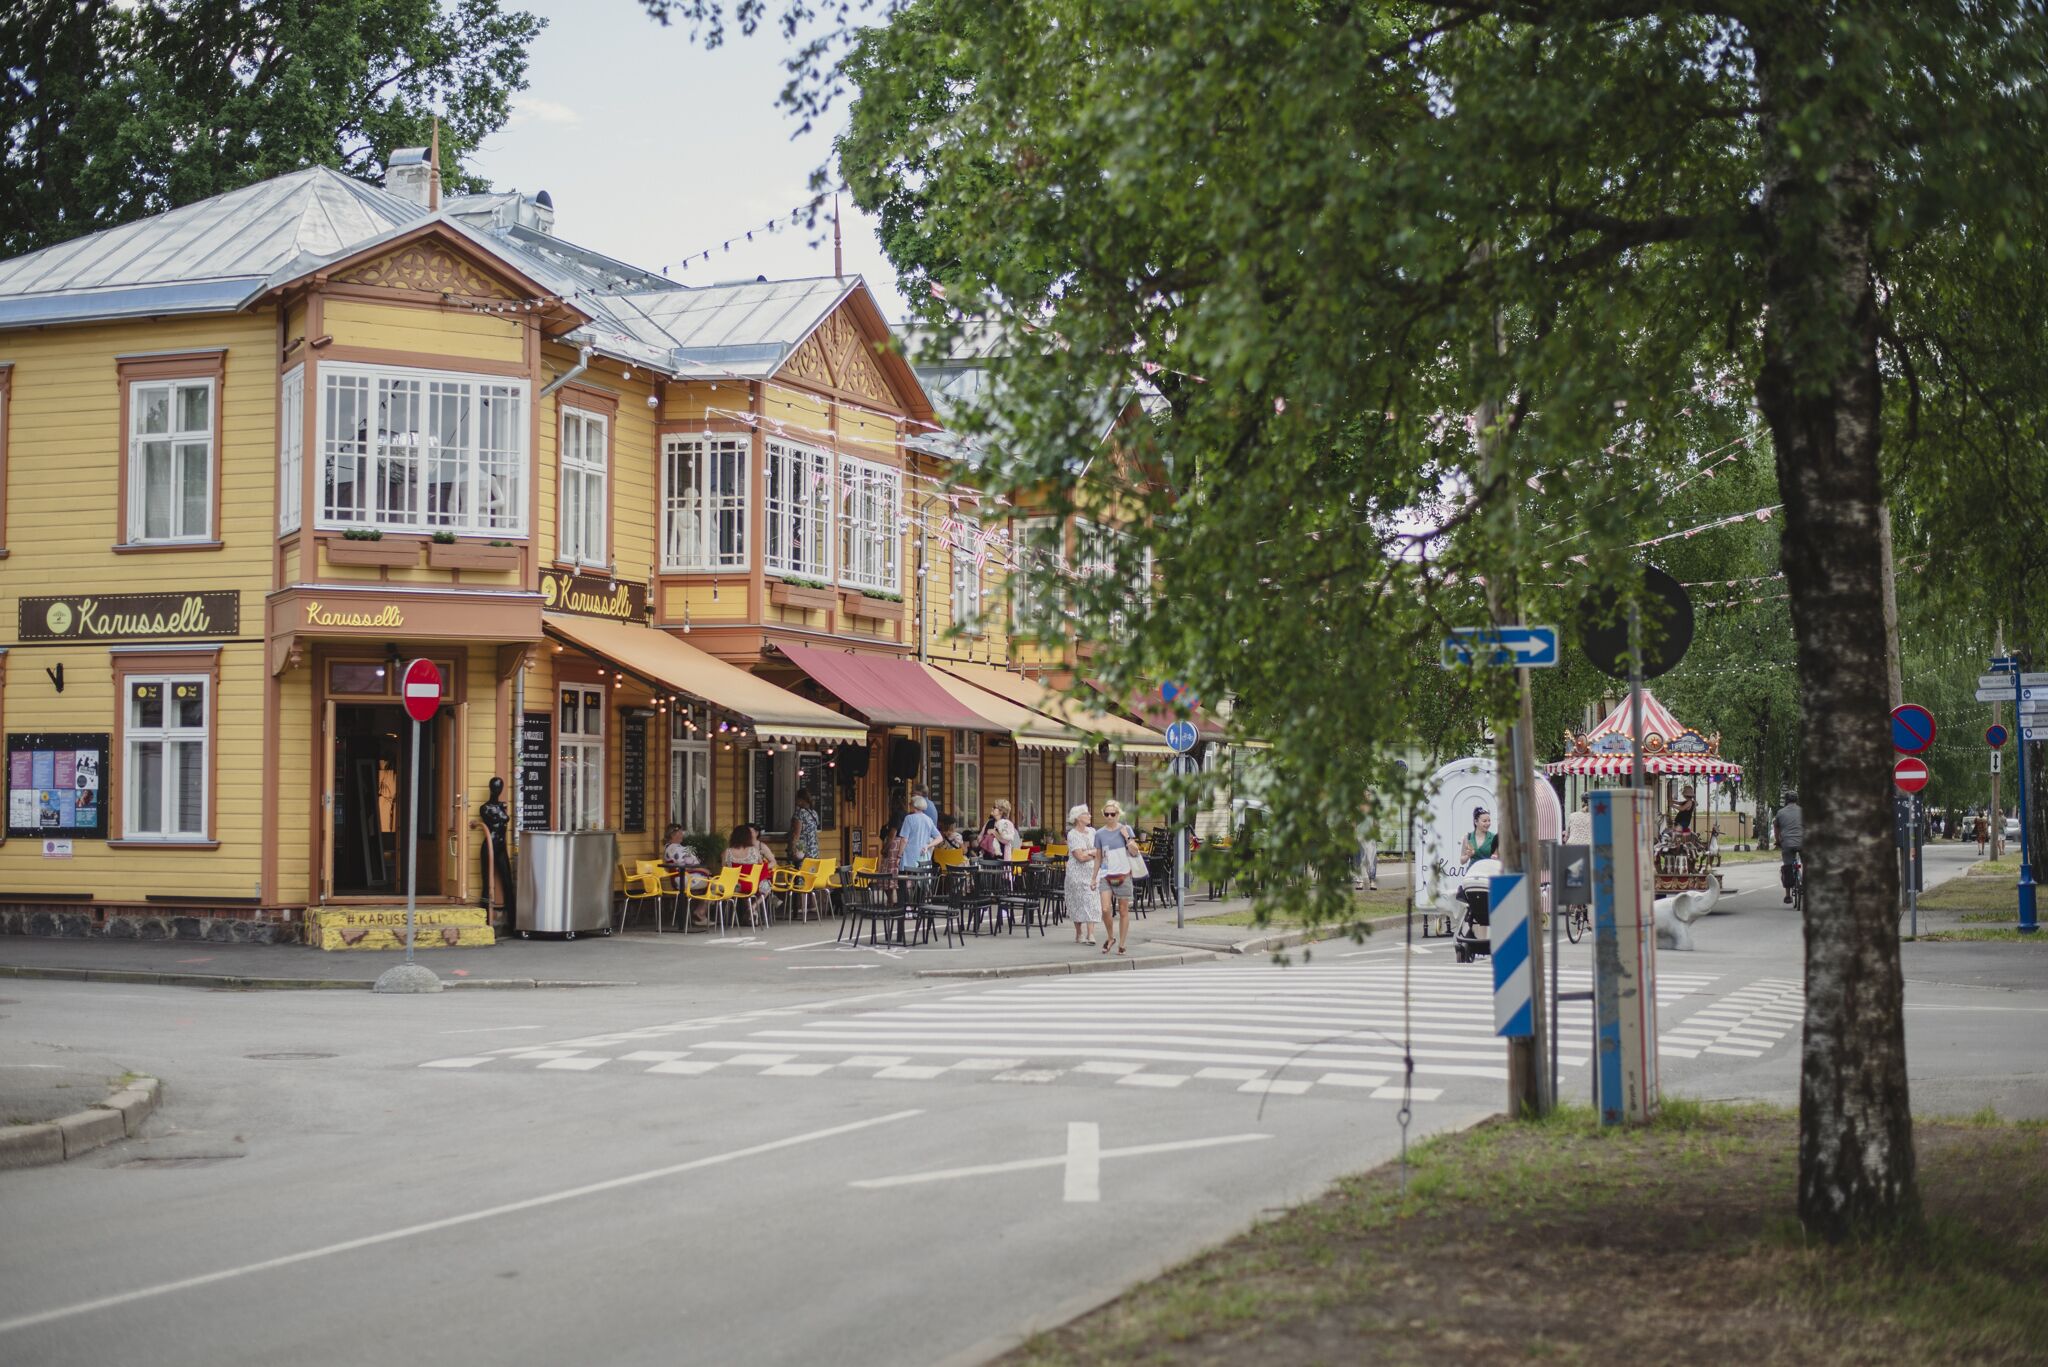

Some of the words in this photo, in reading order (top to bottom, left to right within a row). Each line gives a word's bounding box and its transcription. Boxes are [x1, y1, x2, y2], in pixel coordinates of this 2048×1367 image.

[558, 574, 632, 618] Karusselli
[77, 596, 210, 635] Karusselli
[306, 601, 404, 628] Karusselli
[1437, 857, 1468, 877] Kar
